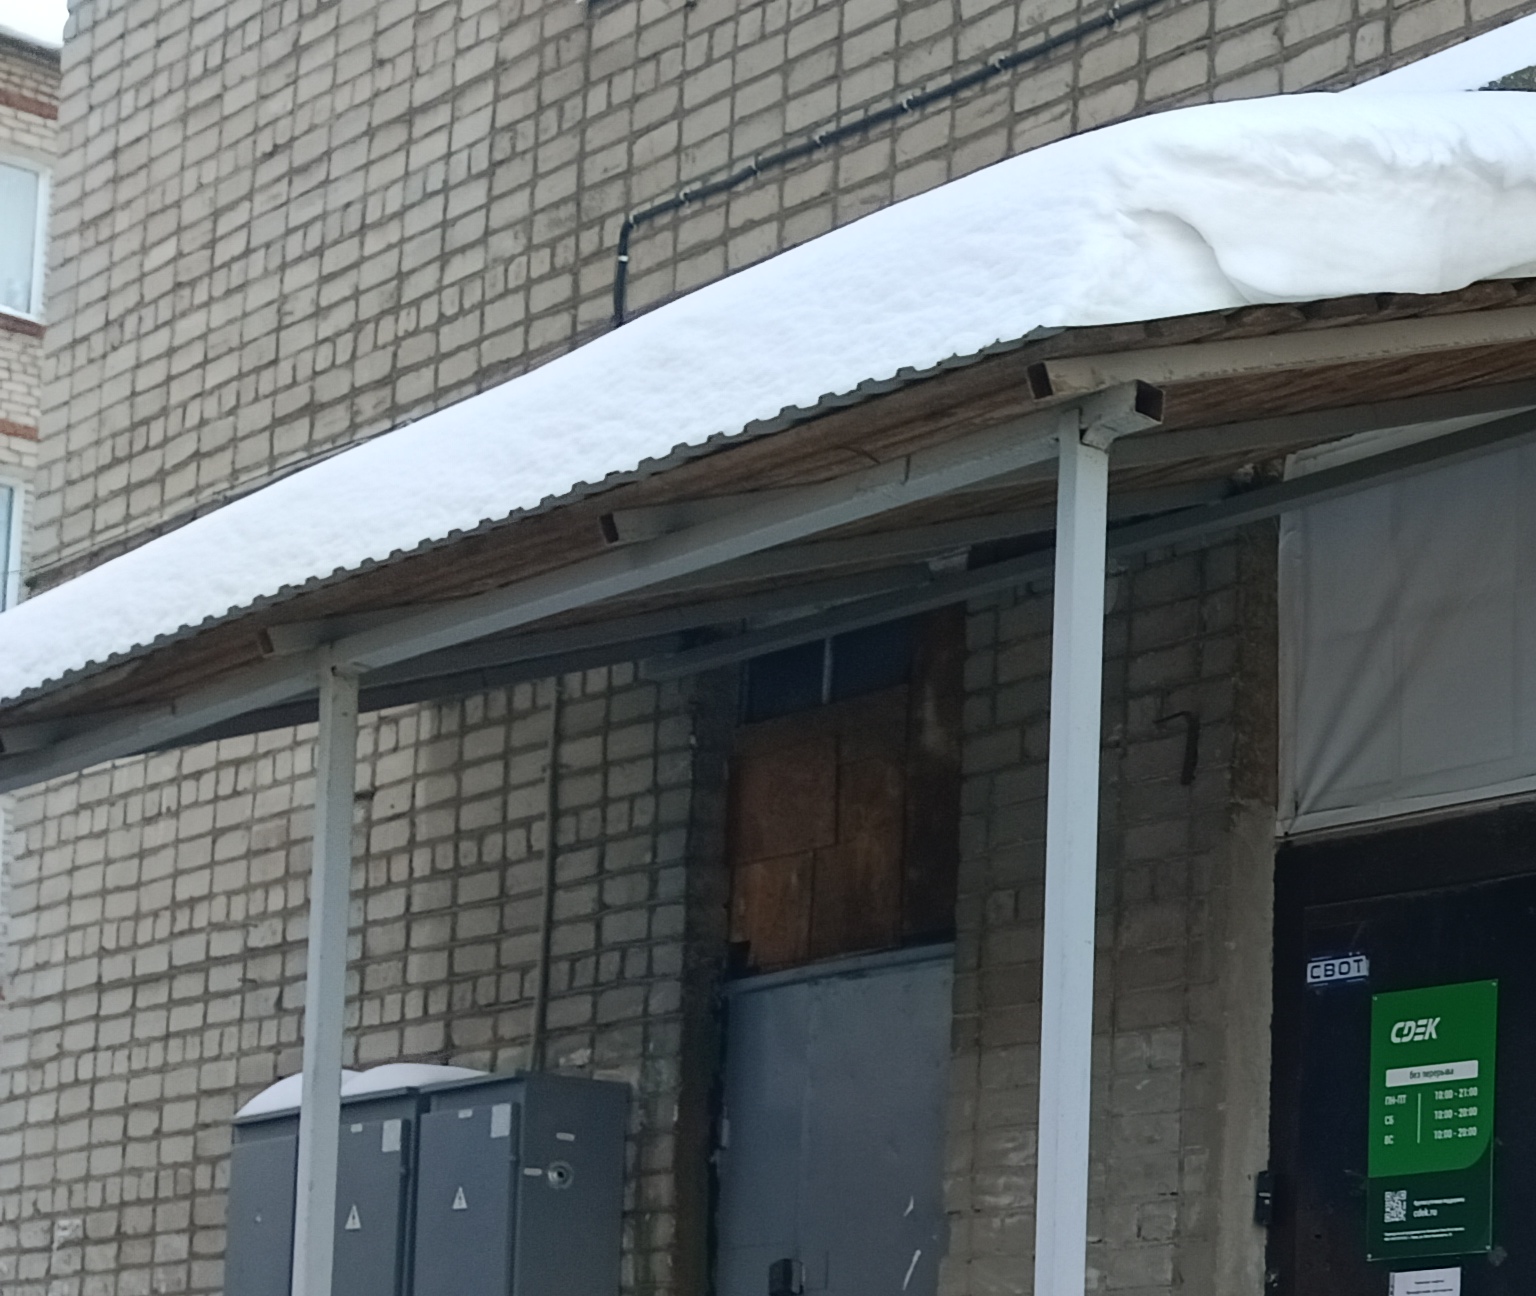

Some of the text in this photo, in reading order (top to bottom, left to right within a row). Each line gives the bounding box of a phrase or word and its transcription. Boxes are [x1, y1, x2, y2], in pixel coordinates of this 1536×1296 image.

[1390, 1017, 1441, 1043] CDEK
[1409, 1068, 1454, 1080] без перерыва
[1384, 1115, 1394, 1125] СБ
